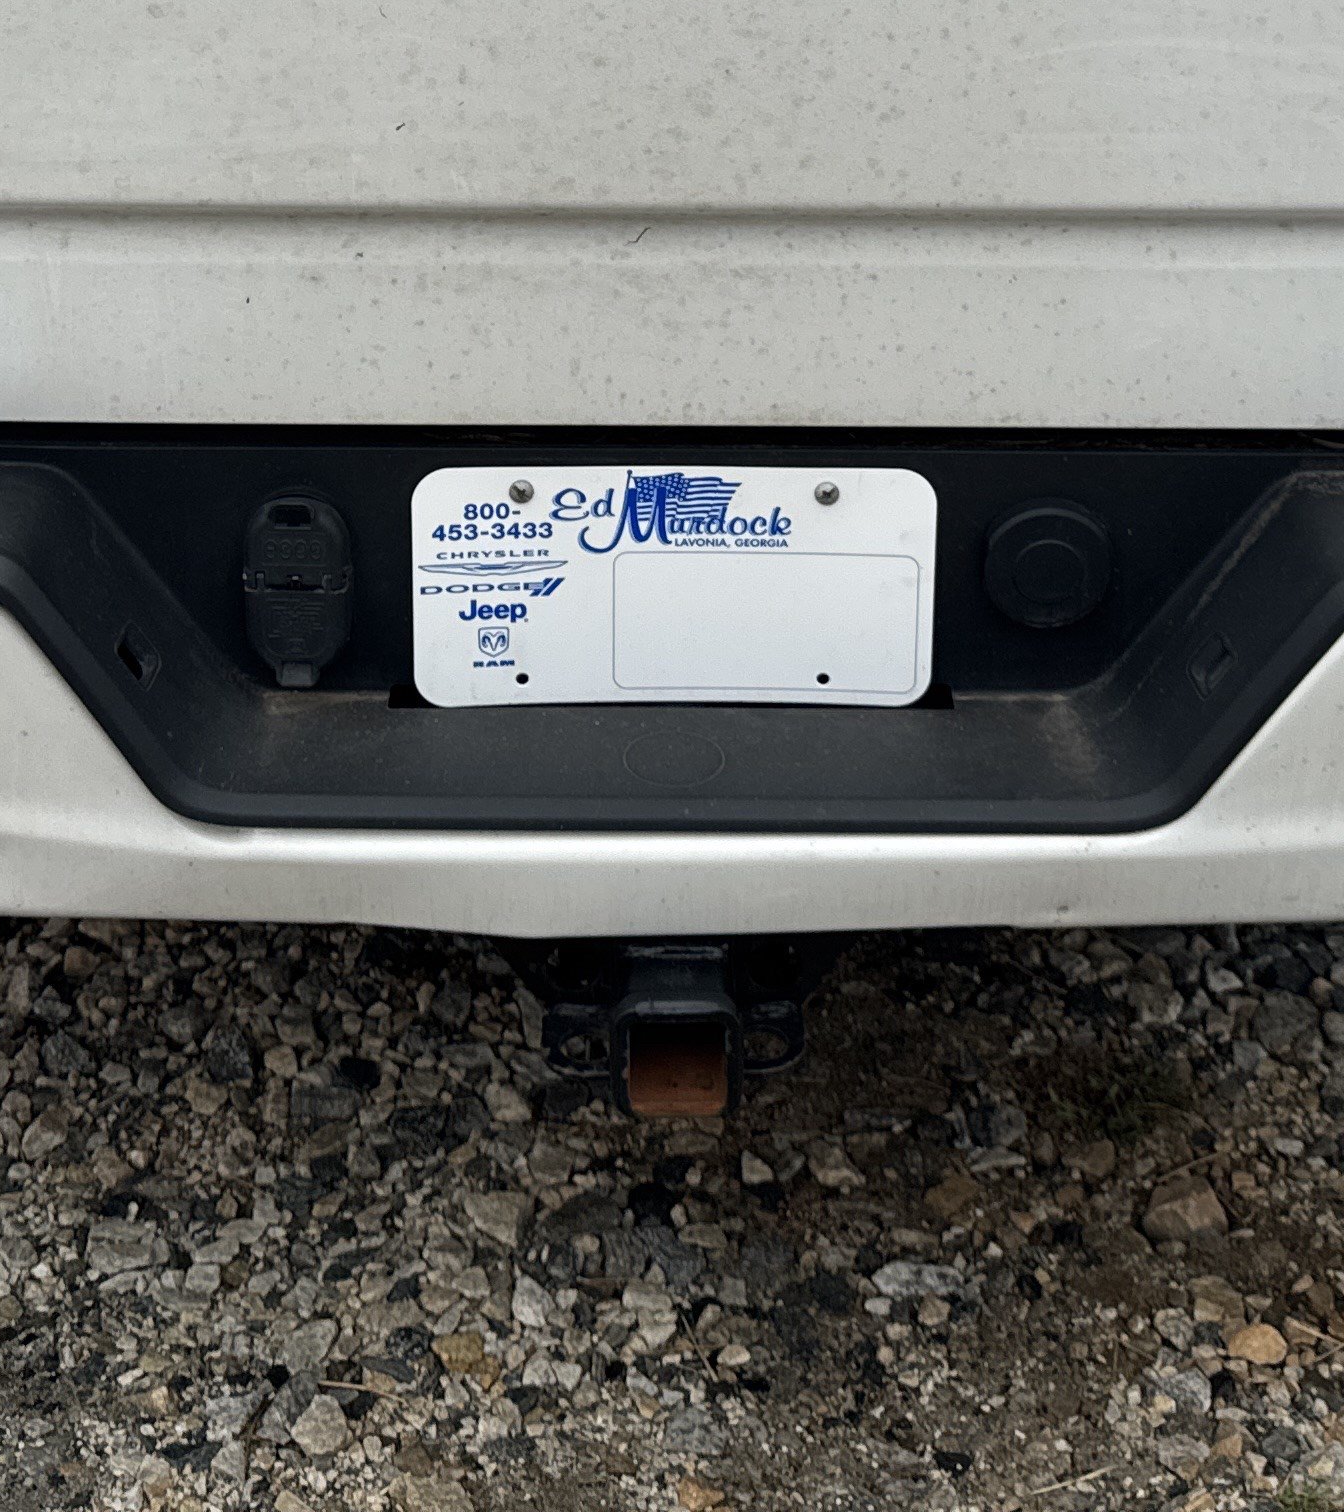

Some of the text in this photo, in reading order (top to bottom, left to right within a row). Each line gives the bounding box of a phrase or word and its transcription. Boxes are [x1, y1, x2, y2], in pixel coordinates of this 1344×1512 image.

[463, 503, 522, 521] 800-
[548, 486, 792, 554] Ed Murdock
[431, 522, 554, 542] 453-3433
[674, 537, 789, 549] LAVONIA, GEORGIA
[436, 548, 550, 560] CHRYSLER
[420, 581, 547, 595] DODGE
[458, 599, 528, 623] Jeep
[472, 659, 516, 668] RAM
